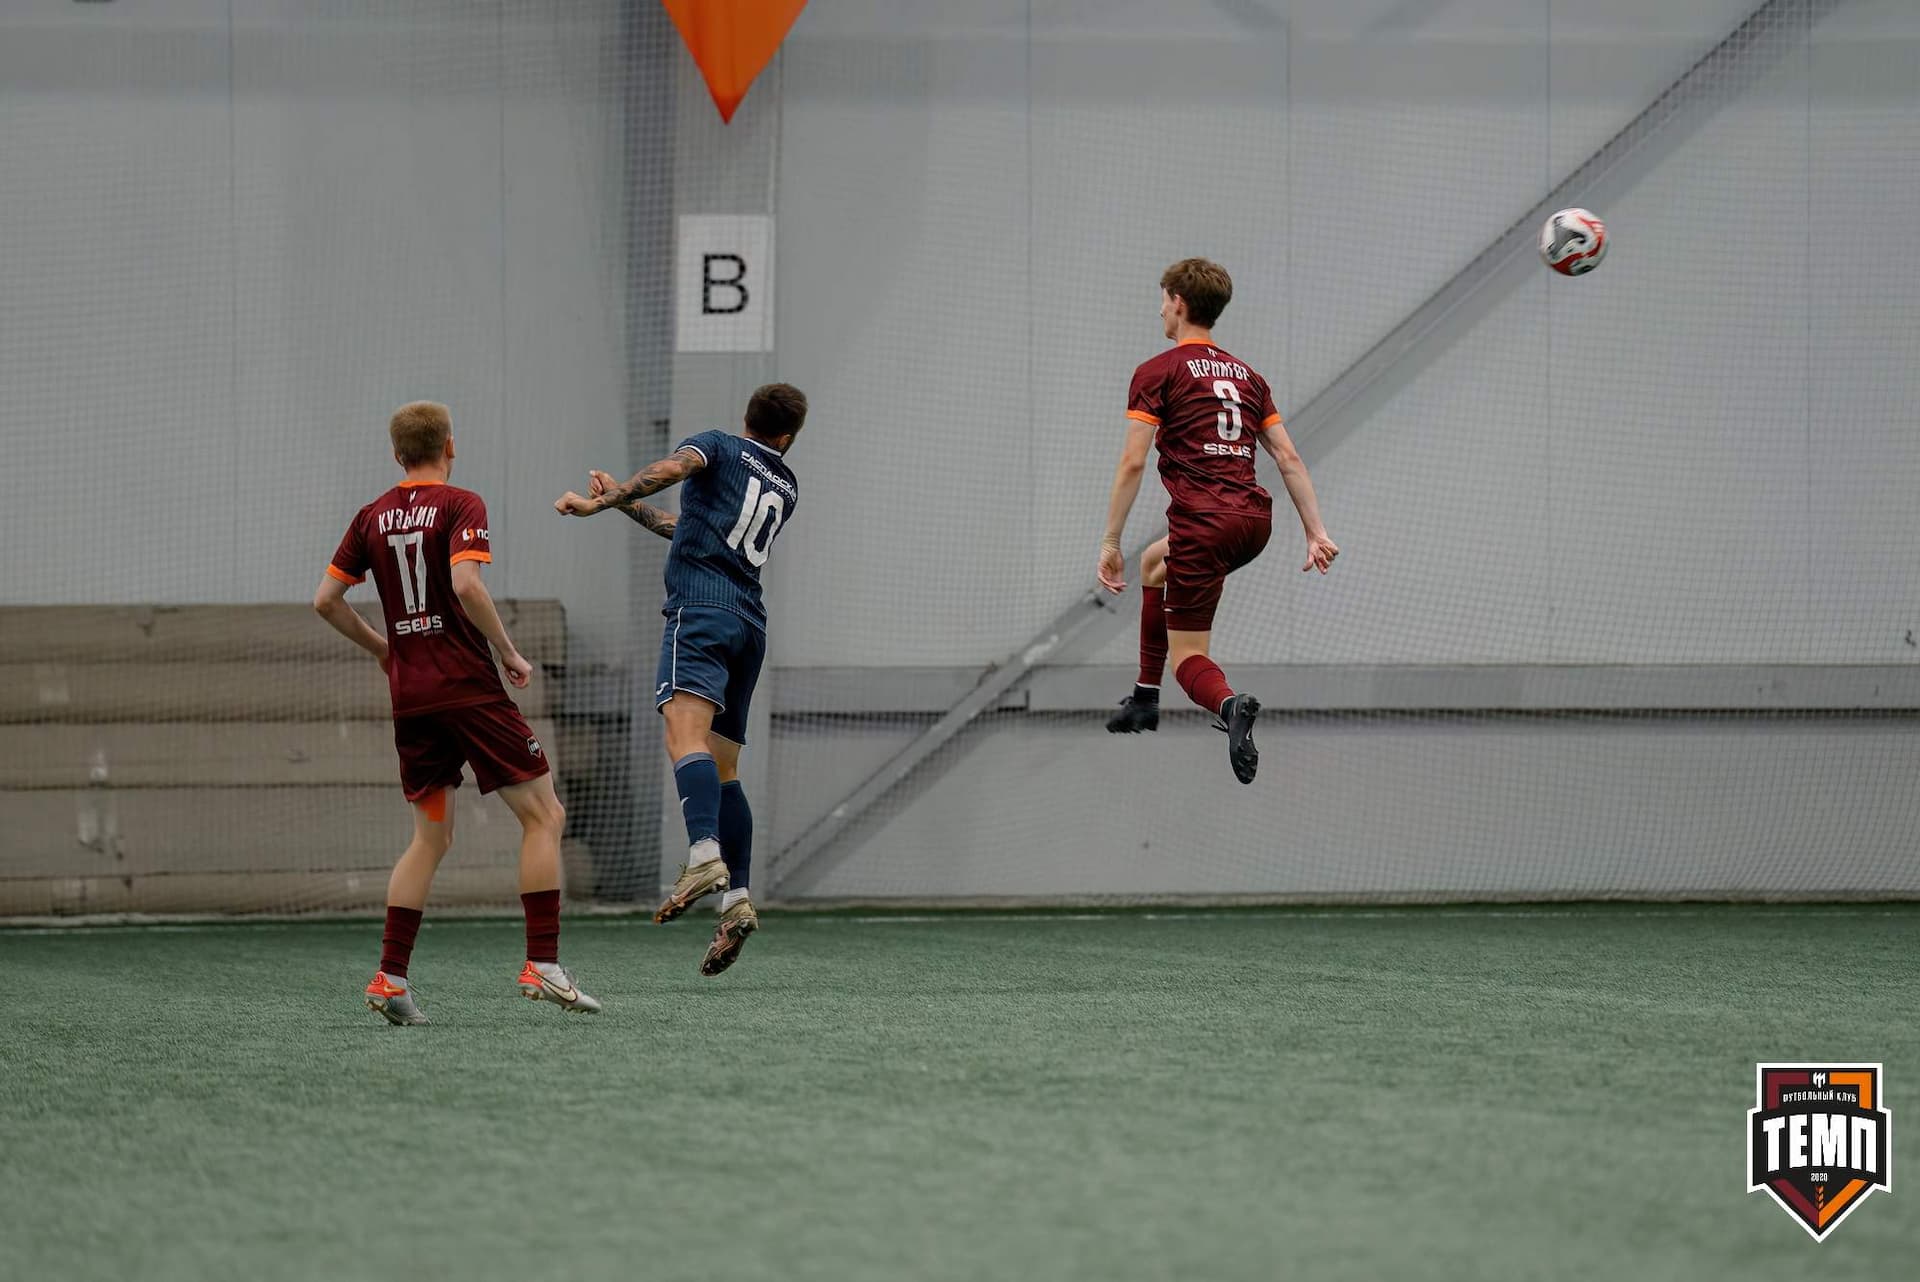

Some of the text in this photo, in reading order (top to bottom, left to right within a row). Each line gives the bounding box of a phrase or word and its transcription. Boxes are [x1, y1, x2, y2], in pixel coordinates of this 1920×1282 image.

[1213, 380, 1242, 441] 3
[1203, 443, 1252, 459] SEUS
[726, 476, 784, 567] 10
[387, 530, 427, 615] 17
[395, 615, 443, 635] SEUS
